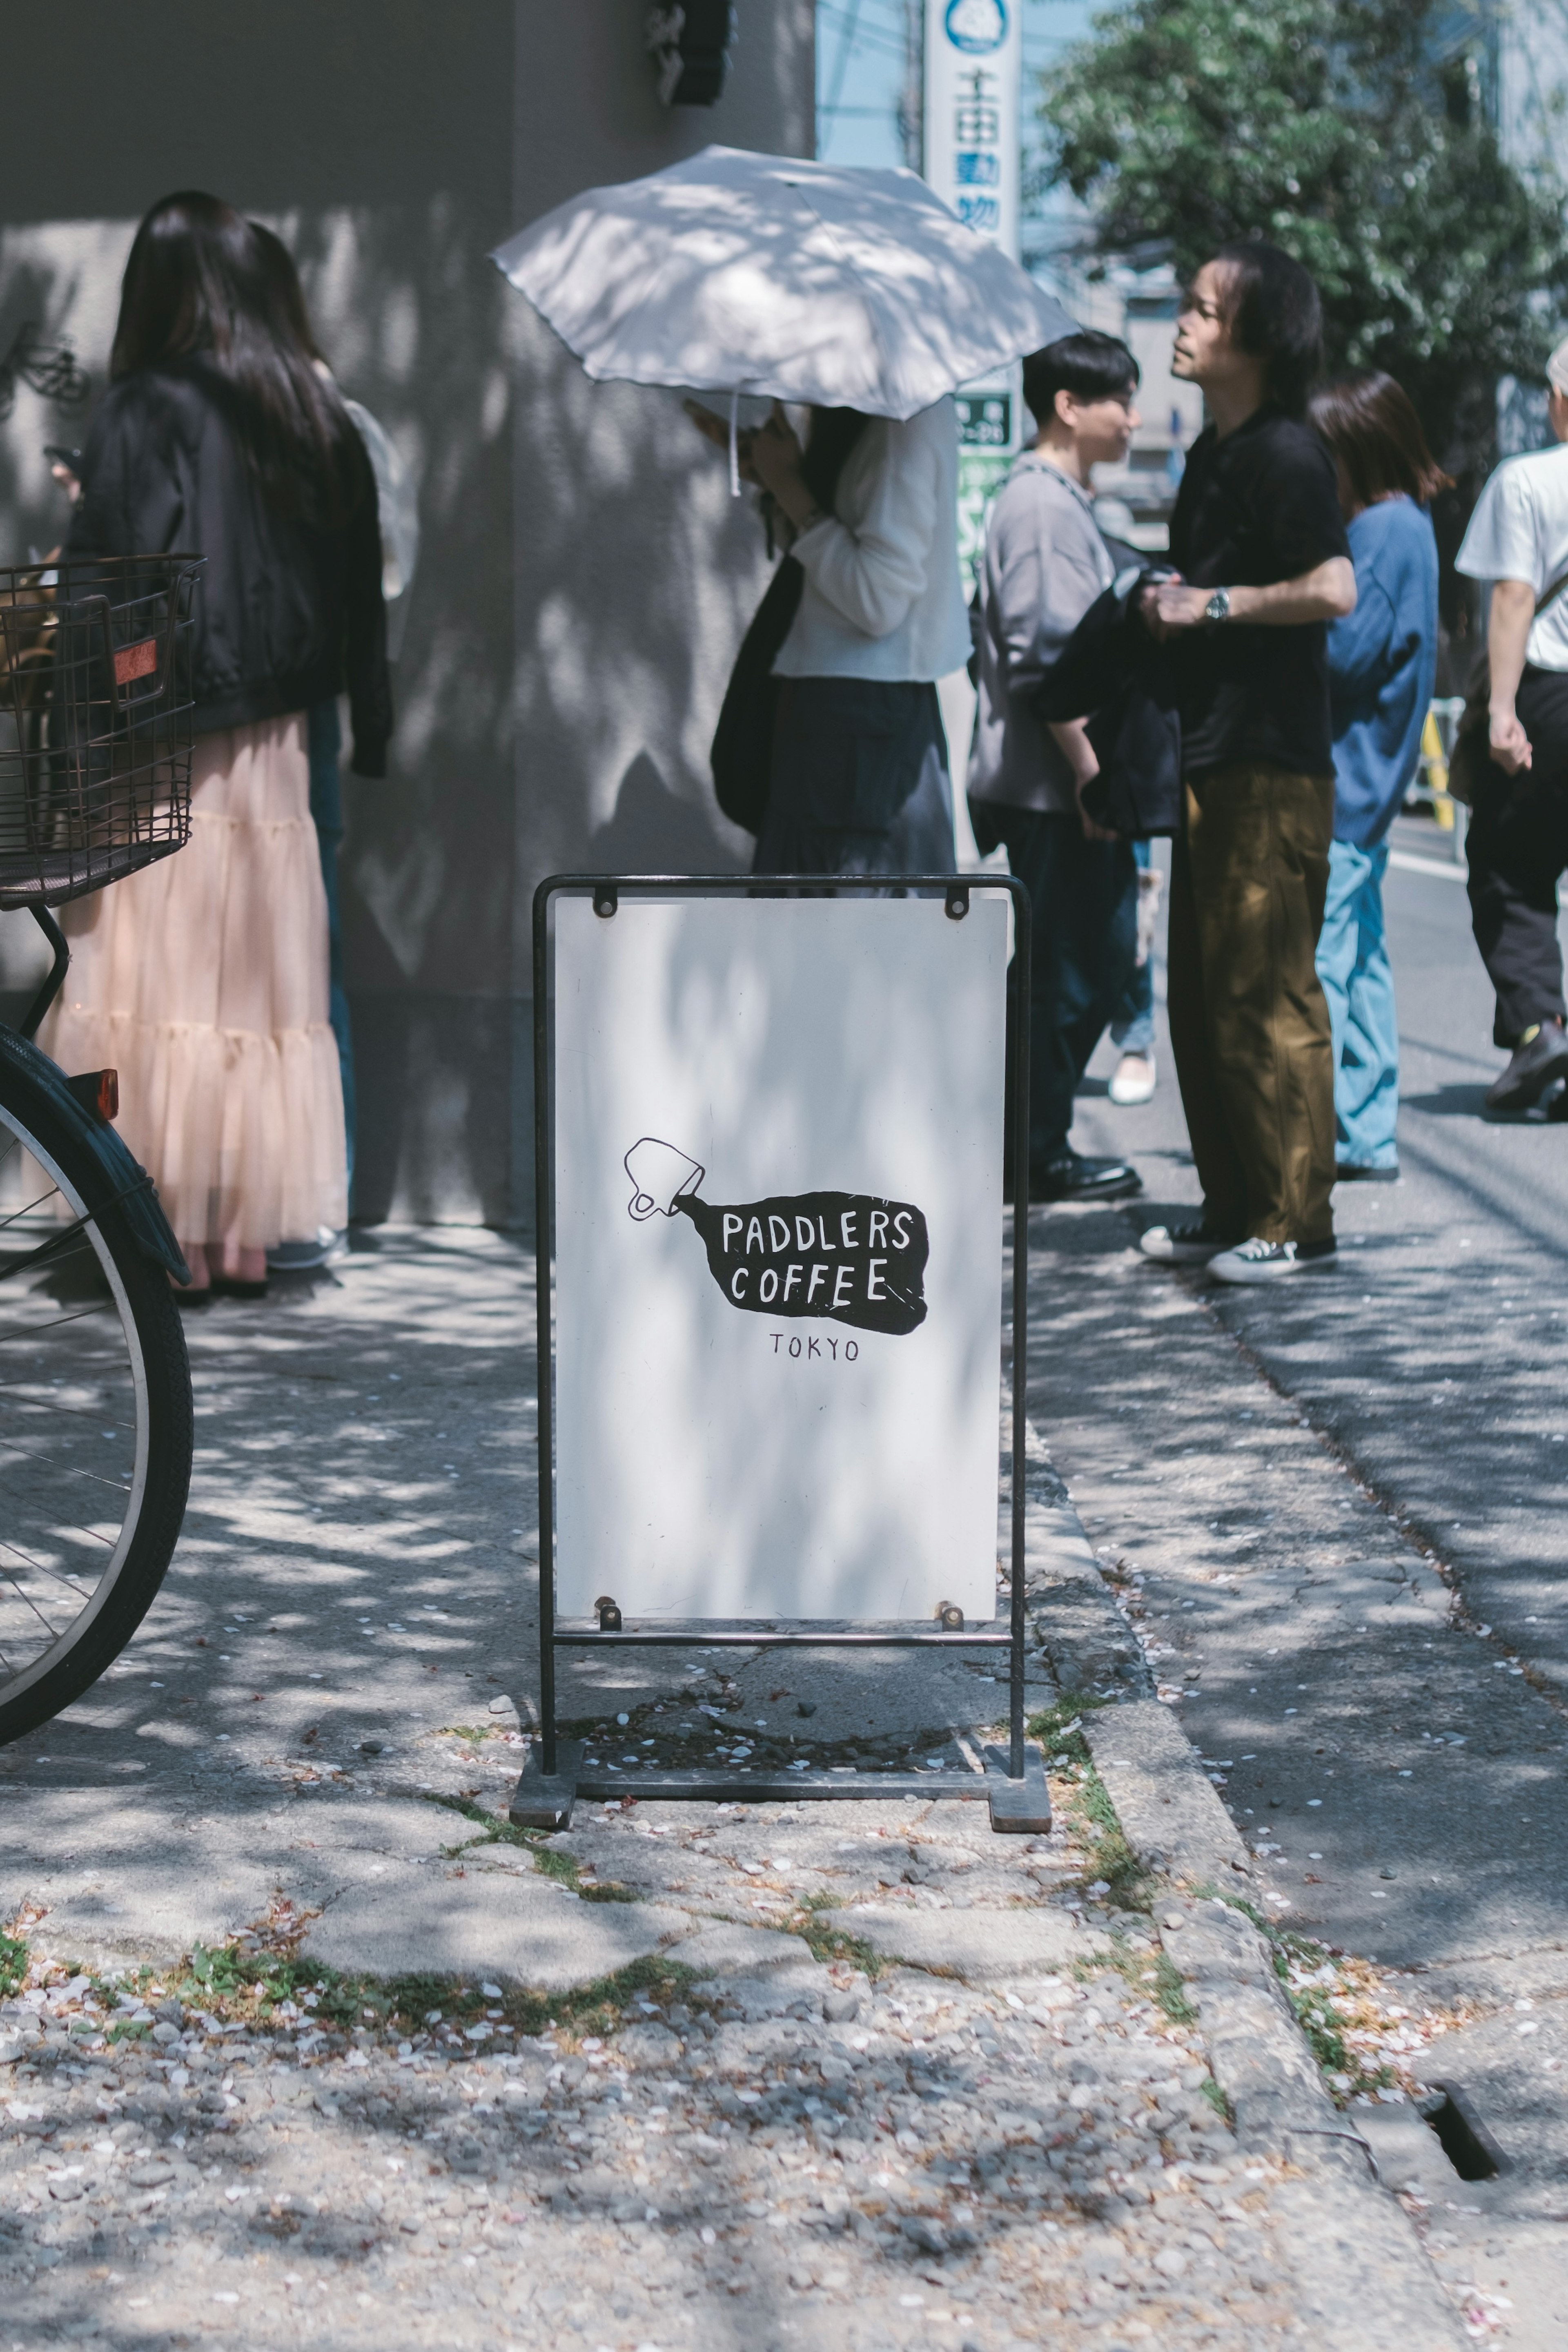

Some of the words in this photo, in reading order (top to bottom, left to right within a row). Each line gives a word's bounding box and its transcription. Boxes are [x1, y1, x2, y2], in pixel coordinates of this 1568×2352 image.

[723, 1211, 914, 1254] PADDLERS
[731, 1259, 887, 1306] COFFEE
[770, 1334, 859, 1361] TOKYO
